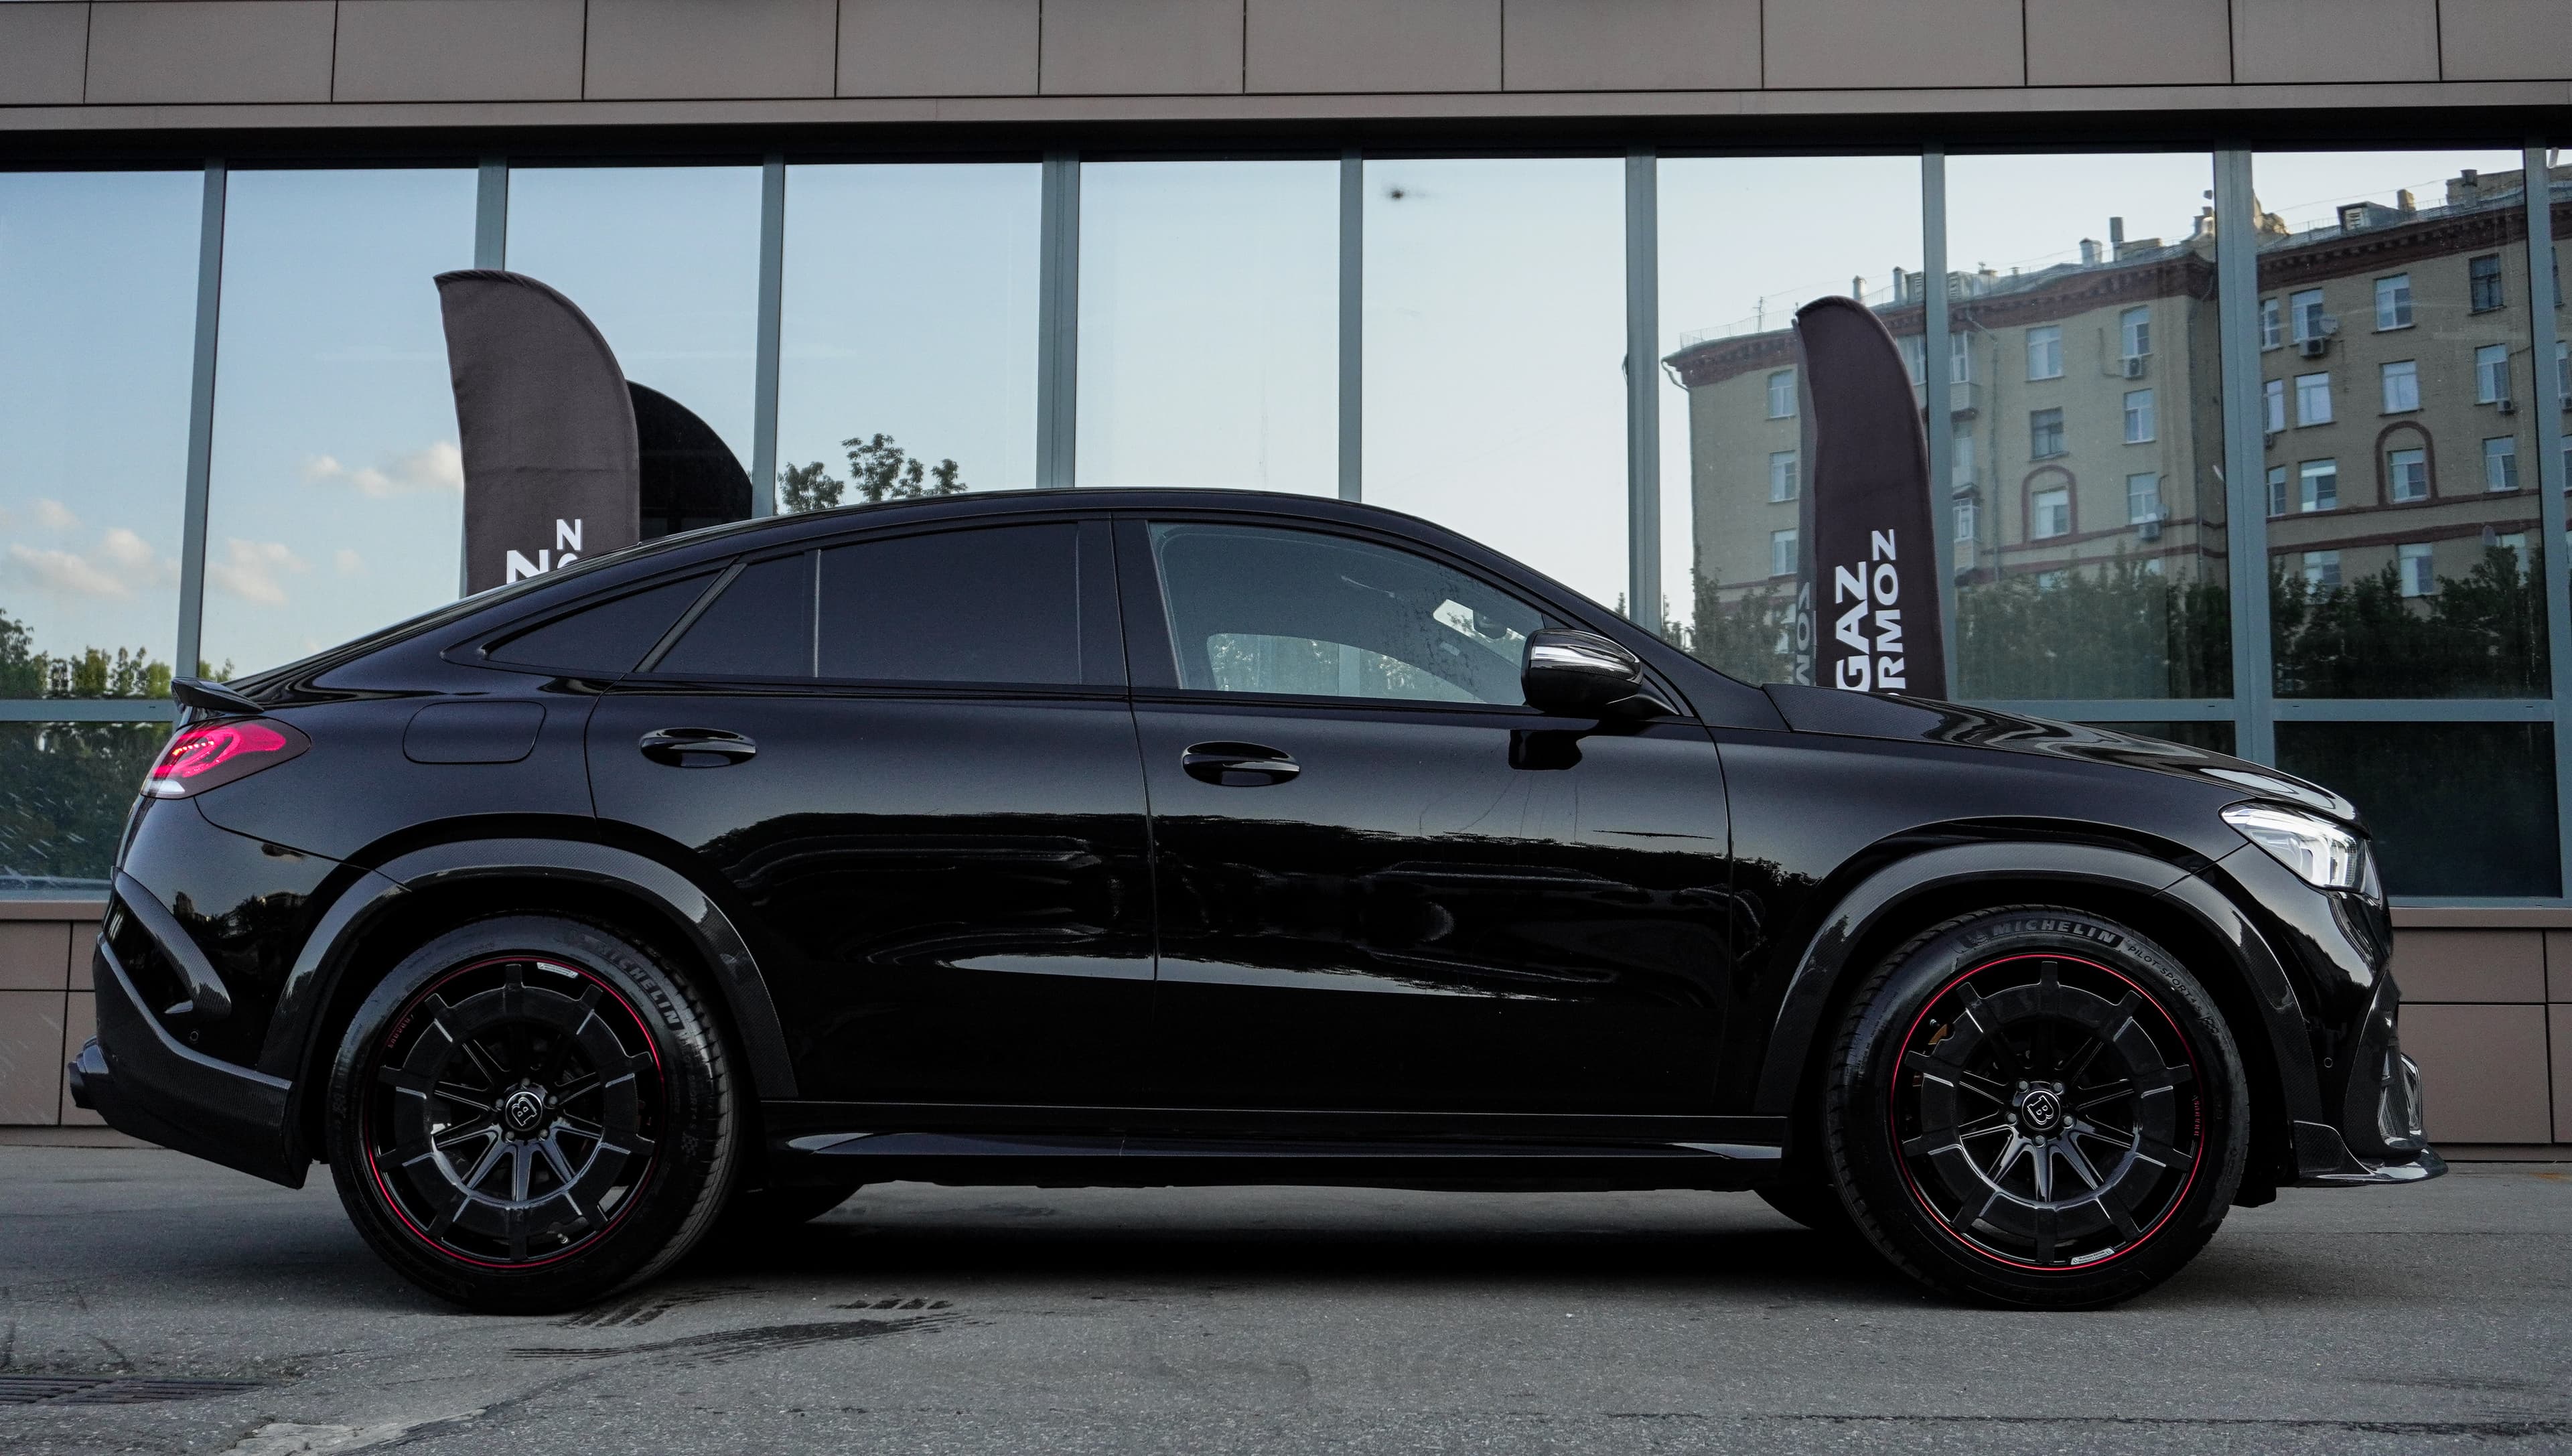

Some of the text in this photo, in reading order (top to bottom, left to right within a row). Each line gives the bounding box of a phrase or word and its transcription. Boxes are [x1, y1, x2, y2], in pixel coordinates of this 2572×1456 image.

[1835, 561, 1871, 693] GAZ
[1871, 528, 1906, 696] RMOZ
[1993, 920, 2116, 944] MICHELIN
[2127, 946, 2160, 966] PILOT
[2159, 968, 2192, 997] SPORT
